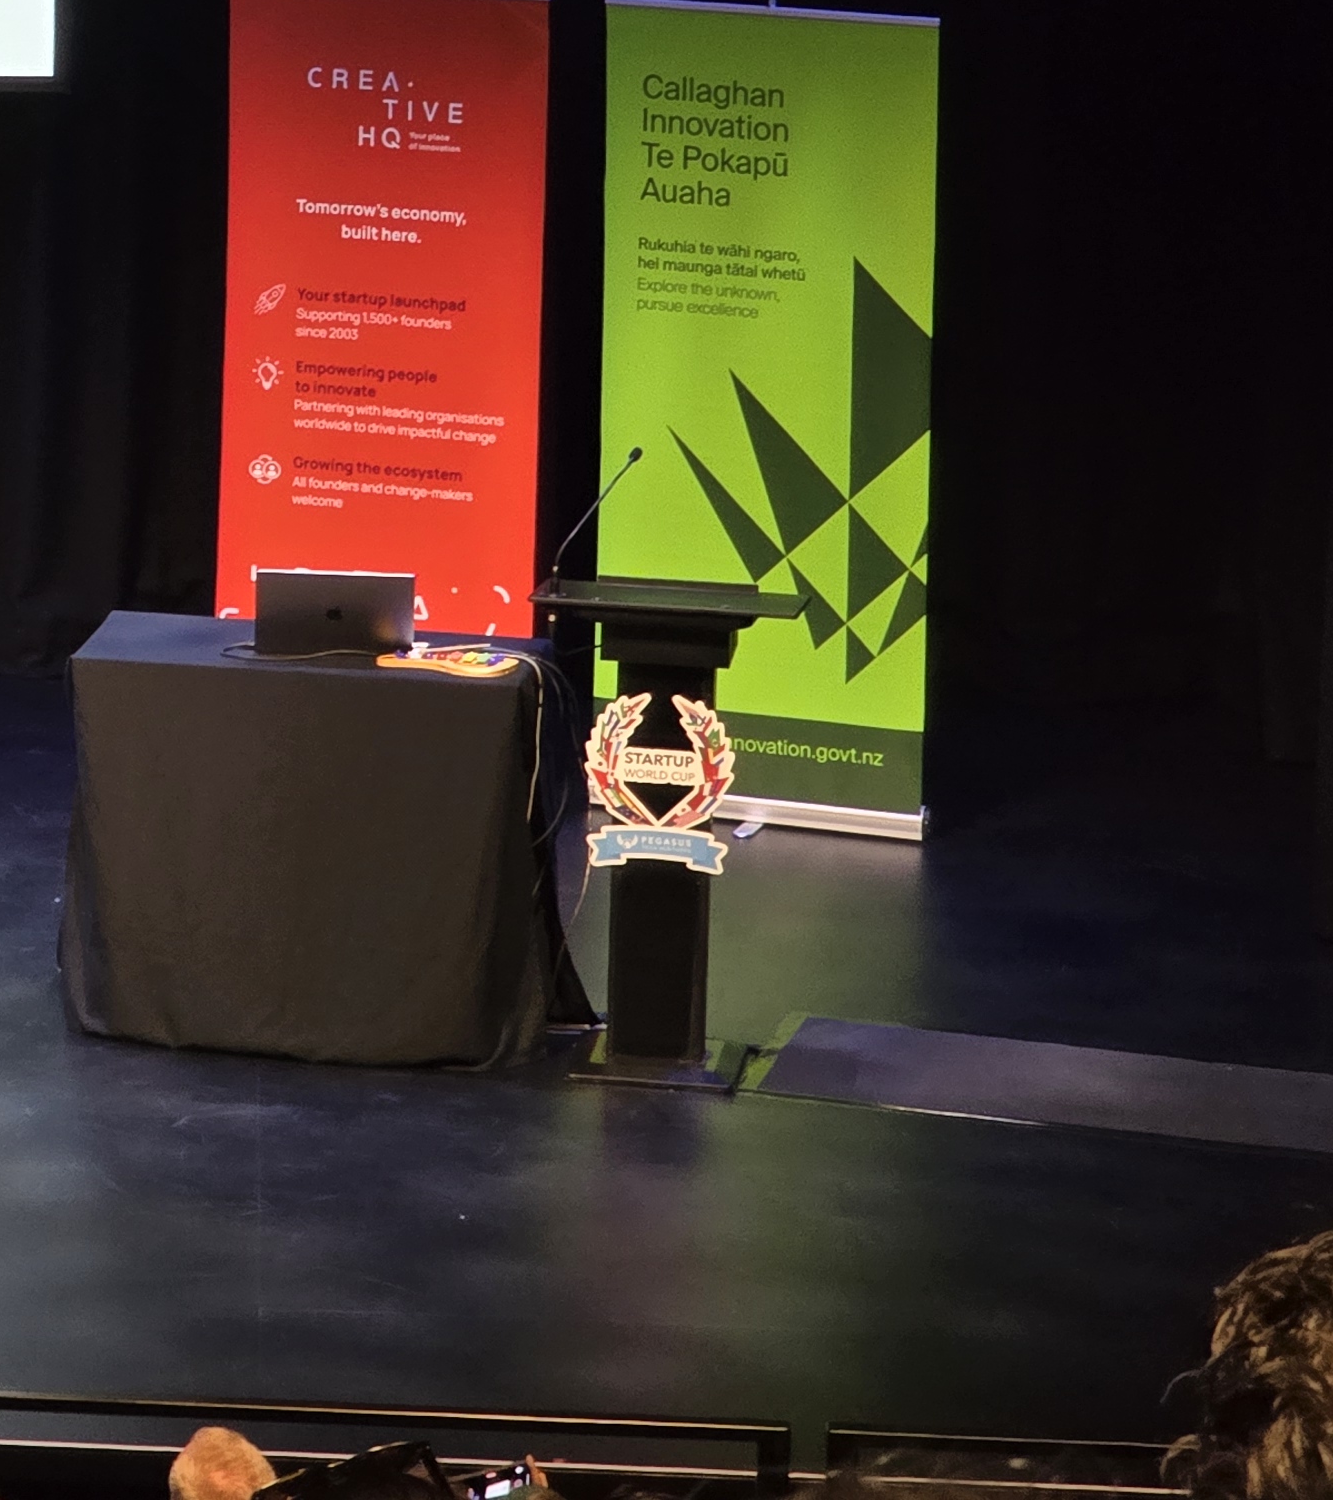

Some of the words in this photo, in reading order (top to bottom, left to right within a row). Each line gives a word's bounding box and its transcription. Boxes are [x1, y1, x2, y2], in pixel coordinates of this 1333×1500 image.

[643, 74, 784, 110] Callaghan
[383, 99, 463, 124] TIVE
[357, 125, 401, 149] HQ
[642, 107, 789, 142] Innovation
[641, 140, 674, 169] Te
[683, 144, 789, 181] Pokapū
[640, 177, 731, 207] Auaha
[391, 206, 467, 226] economy,
[341, 224, 378, 241] built
[381, 227, 422, 244] here.
[638, 236, 696, 254] Rukuhia
[699, 242, 714, 255] te
[754, 248, 800, 264] ngaro,
[637, 255, 659, 270] hei
[662, 259, 723, 276] maunga
[297, 287, 330, 301] Your
[334, 291, 387, 309] startup
[390, 294, 466, 314] launchpad
[637, 277, 688, 294] Explore
[691, 282, 713, 296] the
[715, 285, 781, 303] unknown,
[296, 307, 361, 326] Supporting
[400, 314, 452, 330] founders
[636, 299, 683, 313] pursue
[686, 301, 759, 319] excellence
[295, 325, 327, 339] since
[328, 327, 359, 340] 2003
[296, 360, 384, 382] Empowering
[388, 367, 437, 386] people
[295, 380, 310, 393] to
[313, 381, 377, 398] innovate
[294, 399, 355, 417] Partnering
[355, 403, 381, 417] with
[383, 405, 424, 423] leading
[426, 410, 504, 427] organisations
[293, 417, 352, 432] worldwide
[353, 421, 367, 433] to
[367, 421, 396, 436] drive
[397, 424, 451, 440] impactful
[452, 429, 497, 446] change
[292, 456, 353, 476] Growing
[356, 461, 381, 475] the
[384, 465, 463, 482] ecosystem
[291, 494, 343, 508] welcome
[292, 476, 307, 488] All
[308, 476, 360, 492] founders
[361, 482, 383, 495] and
[384, 483, 474, 502] change-makers
[624, 751, 695, 768] STARTUP
[729, 737, 884, 767] novation.govt.nz
[623, 768, 668, 780] WORLD
[671, 771, 695, 782] CUP
[641, 836, 692, 847] PEGASUS
